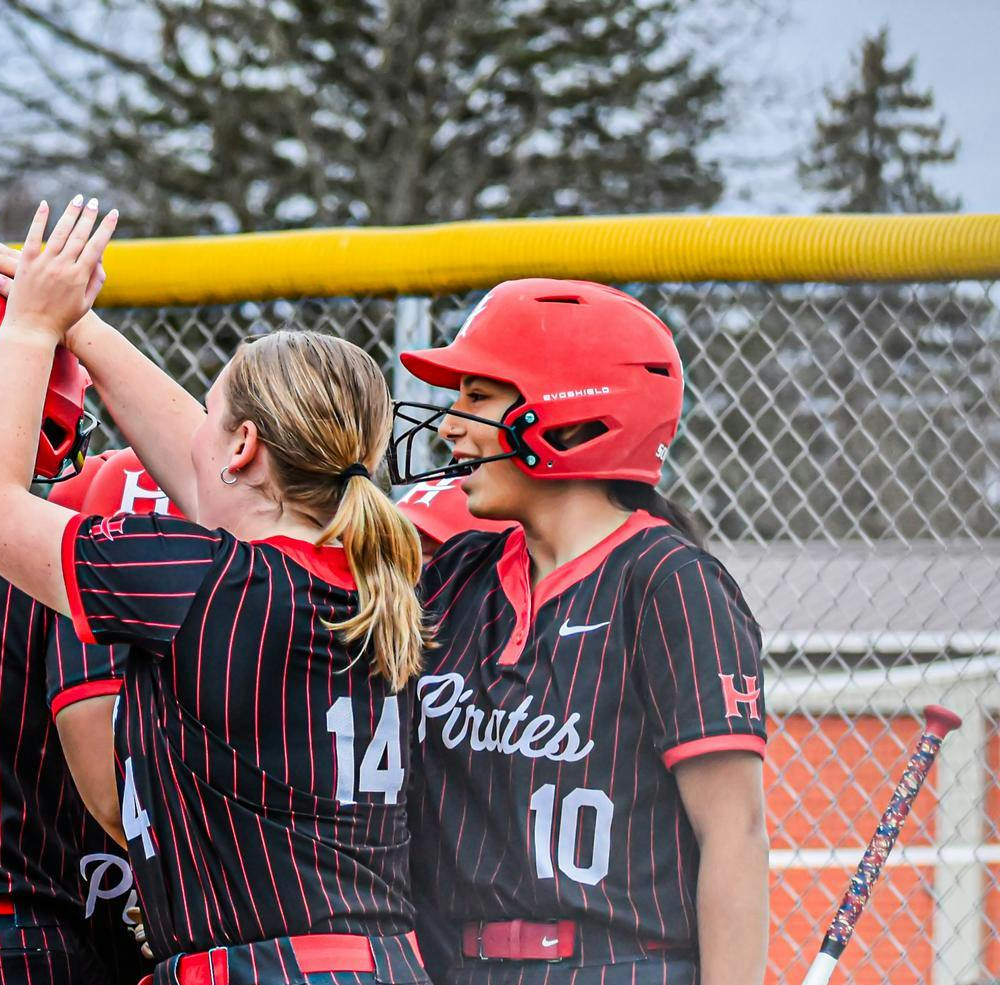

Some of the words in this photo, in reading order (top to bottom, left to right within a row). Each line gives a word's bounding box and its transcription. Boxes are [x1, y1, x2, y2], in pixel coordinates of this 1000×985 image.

[417, 672, 595, 763] Pirates
[718, 673, 761, 721] H
[325, 695, 405, 806] 14
[530, 783, 614, 886] 10
